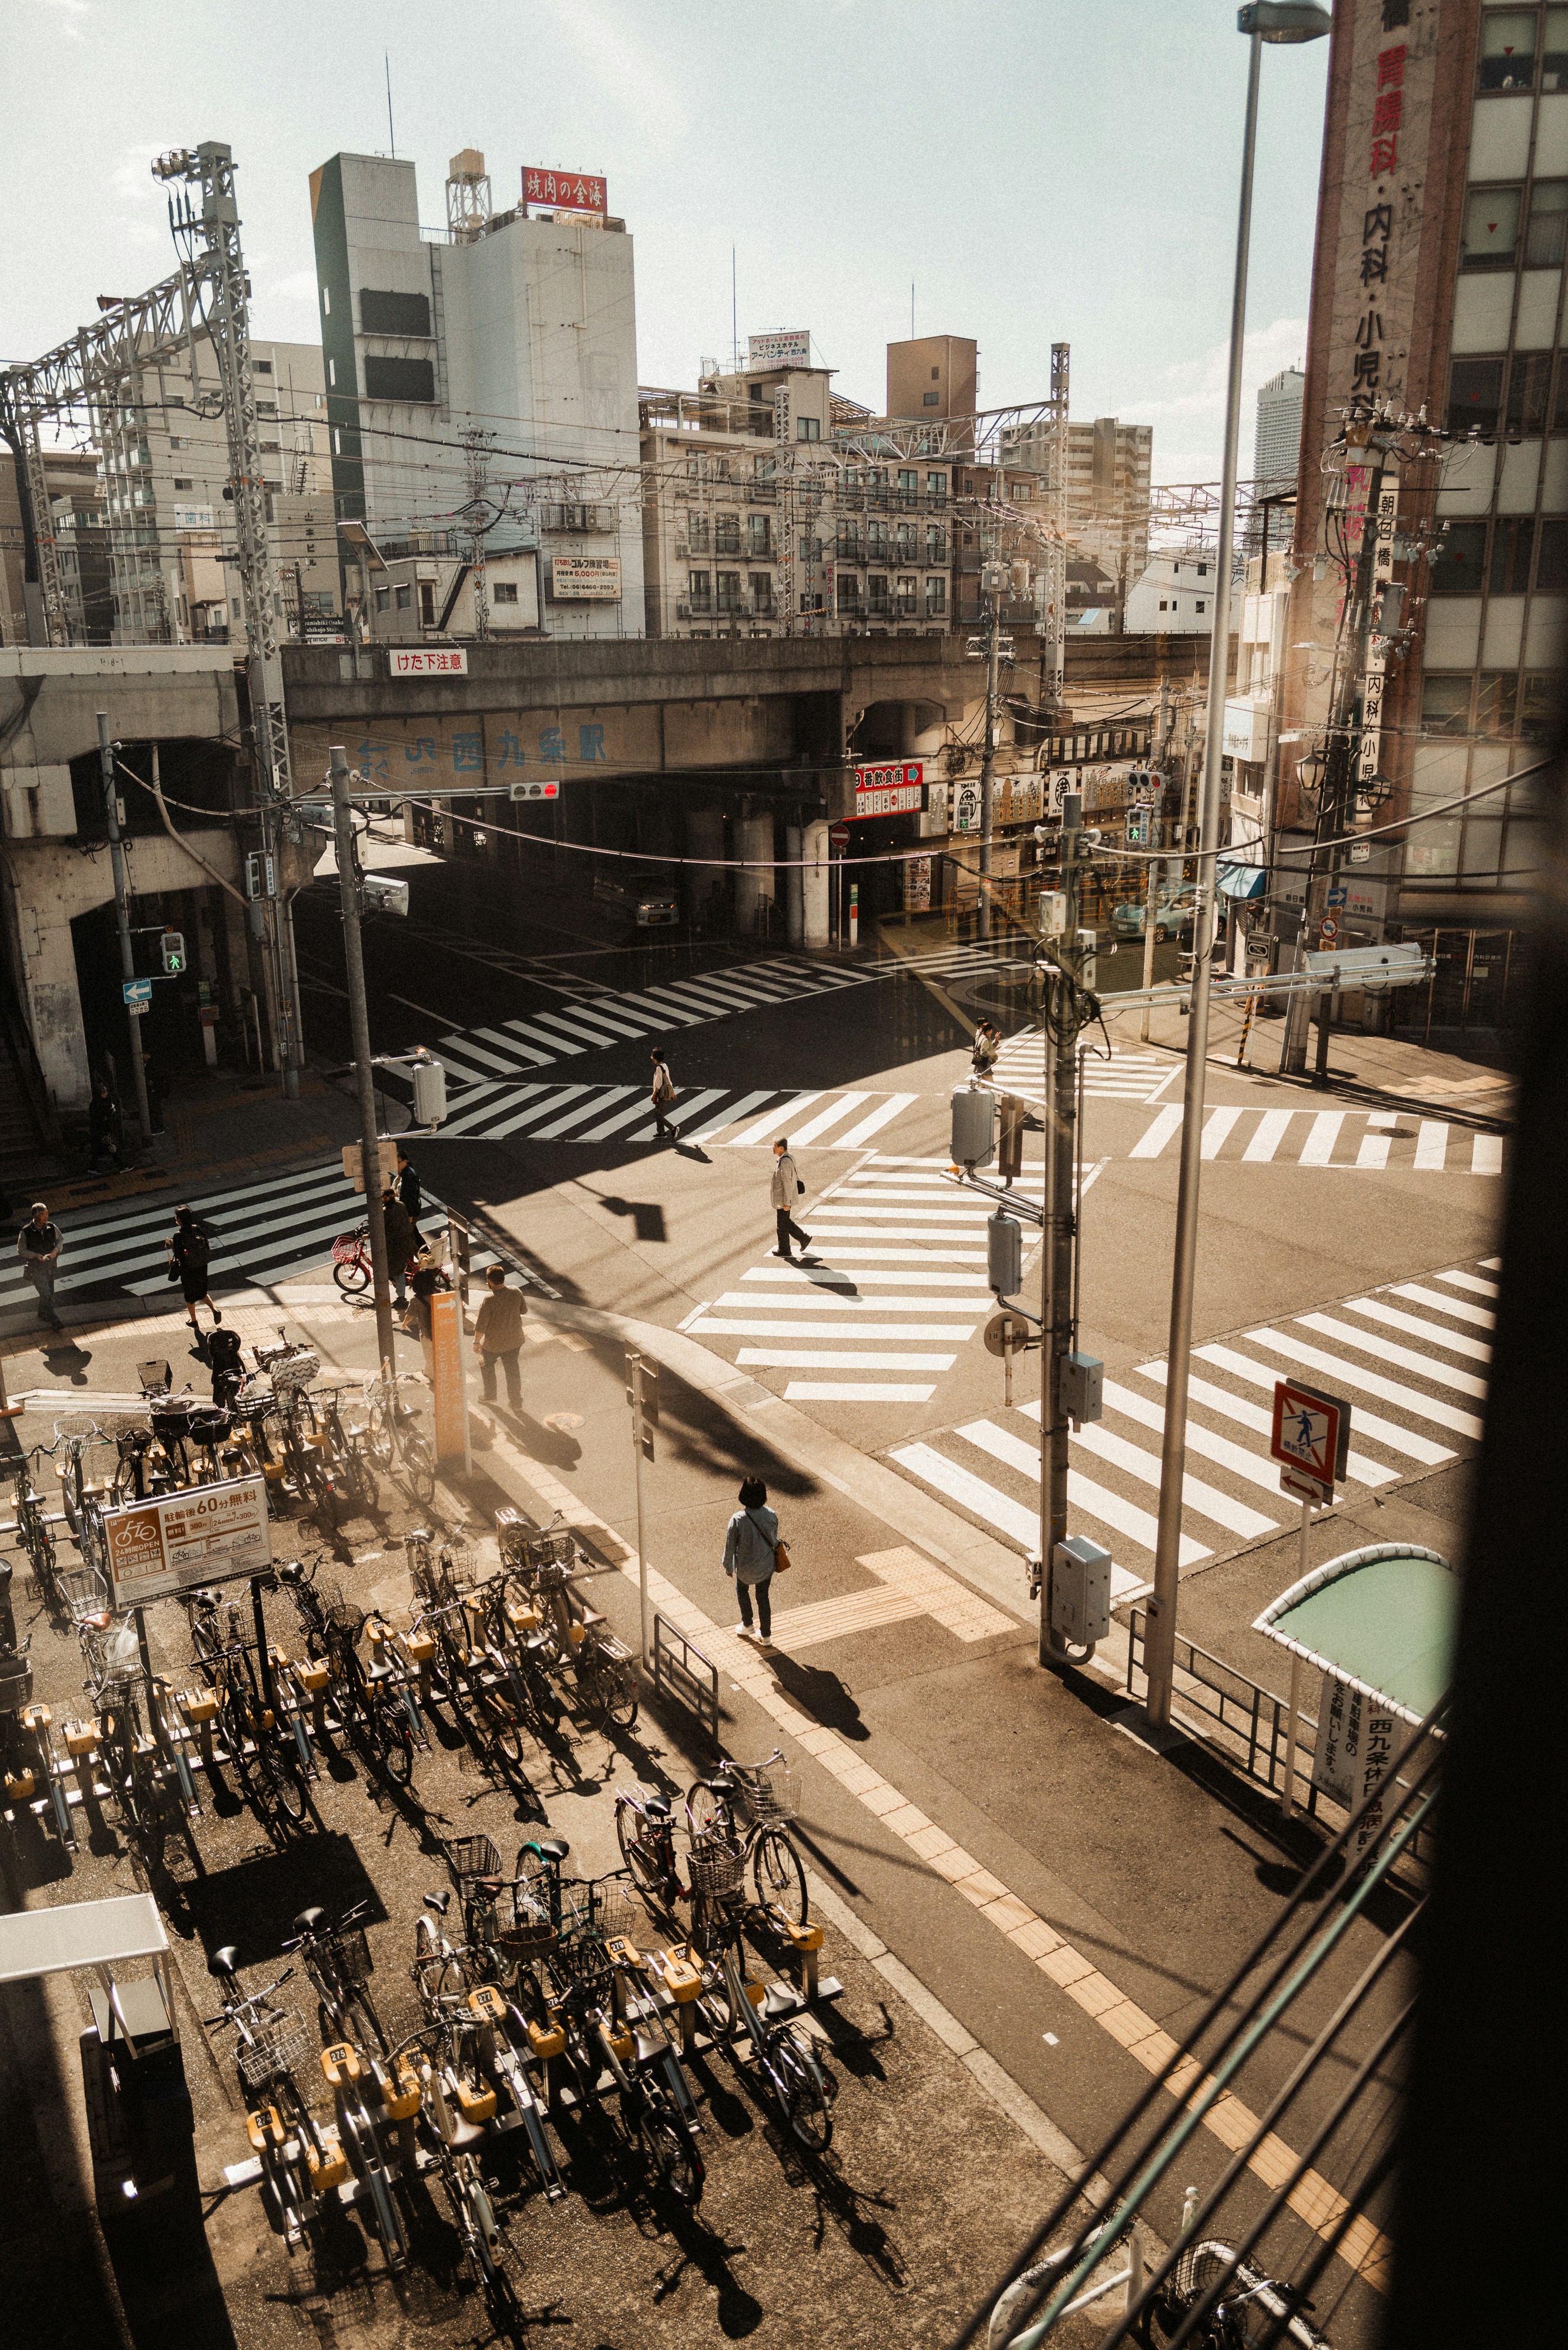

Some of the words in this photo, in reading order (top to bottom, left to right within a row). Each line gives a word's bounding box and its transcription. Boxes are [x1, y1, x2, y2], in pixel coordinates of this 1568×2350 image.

[528, 172, 603, 206] 焼肉の金海
[753, 334, 805, 344] アットホームな雰囲気の
[760, 342, 799, 350] ビジネスホテル
[185, 512, 210, 524] 歯科
[1377, 495, 1394, 567] 朝日橋
[304, 512, 316, 566] 山本ビル
[571, 559, 609, 569] ゴルフ練習場
[397, 654, 462, 670] けた下注意
[359, 760, 388, 780] すぐ
[1284, 1440, 1312, 1462] 横断禁止
[164, 1489, 257, 1523] 駐輪後60分無料
[190, 1522, 207, 1530] 300円
[115, 1540, 160, 1556] 24時間OPEN
[611, 1940, 625, 1952] 279
[478, 1992, 492, 2003] 277
[546, 1997, 559, 2007] 278
[331, 2049, 346, 2060] 275
[257, 2114, 272, 2126] 274
